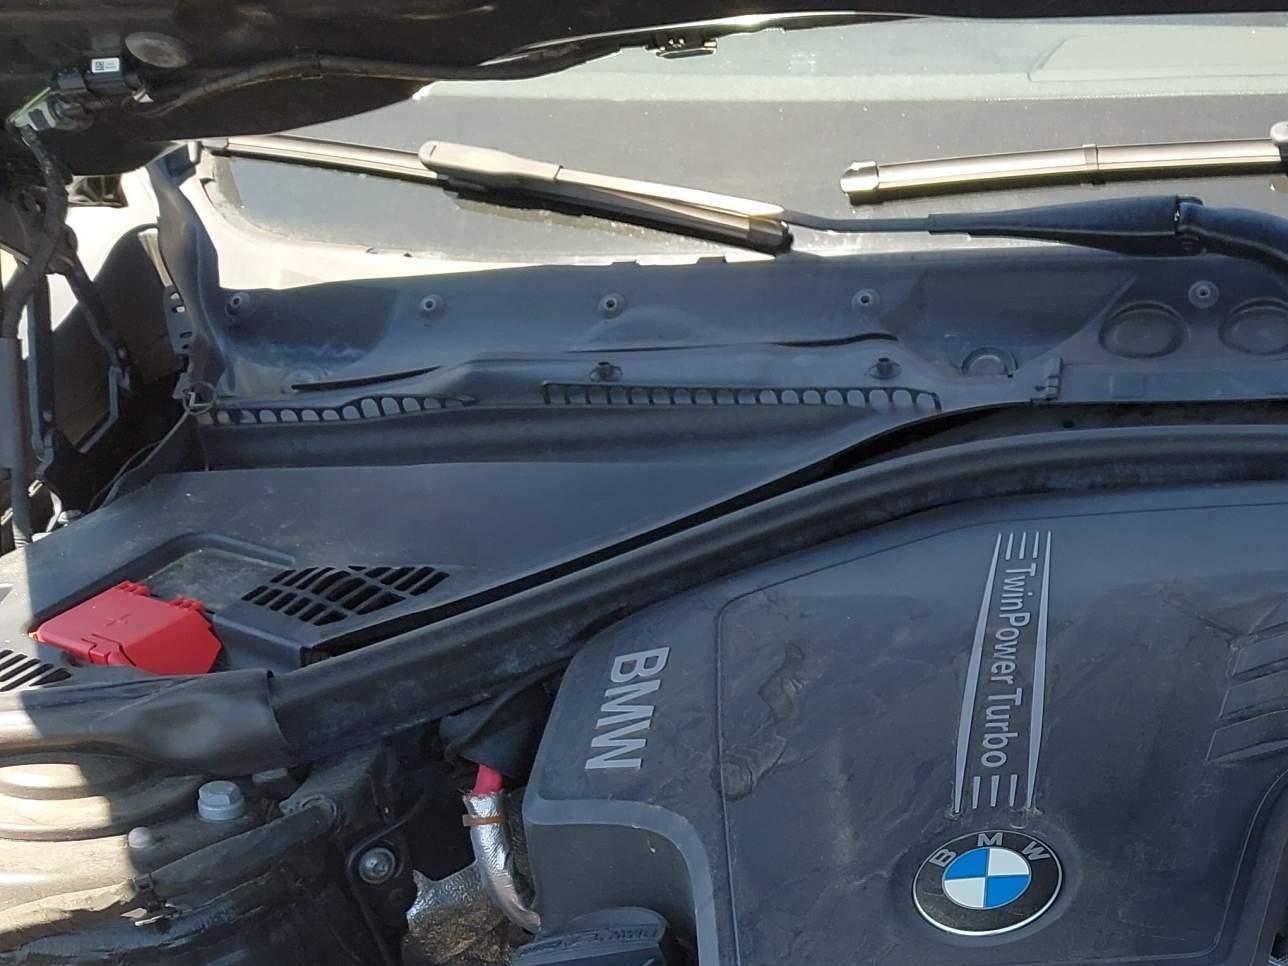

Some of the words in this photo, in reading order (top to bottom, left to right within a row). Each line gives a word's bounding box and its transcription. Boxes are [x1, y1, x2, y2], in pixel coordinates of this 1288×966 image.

[989, 562, 1037, 685] TwinPower
[585, 646, 671, 770] BMW
[980, 687, 1023, 768] Turbo
[928, 831, 1051, 868] BMW
